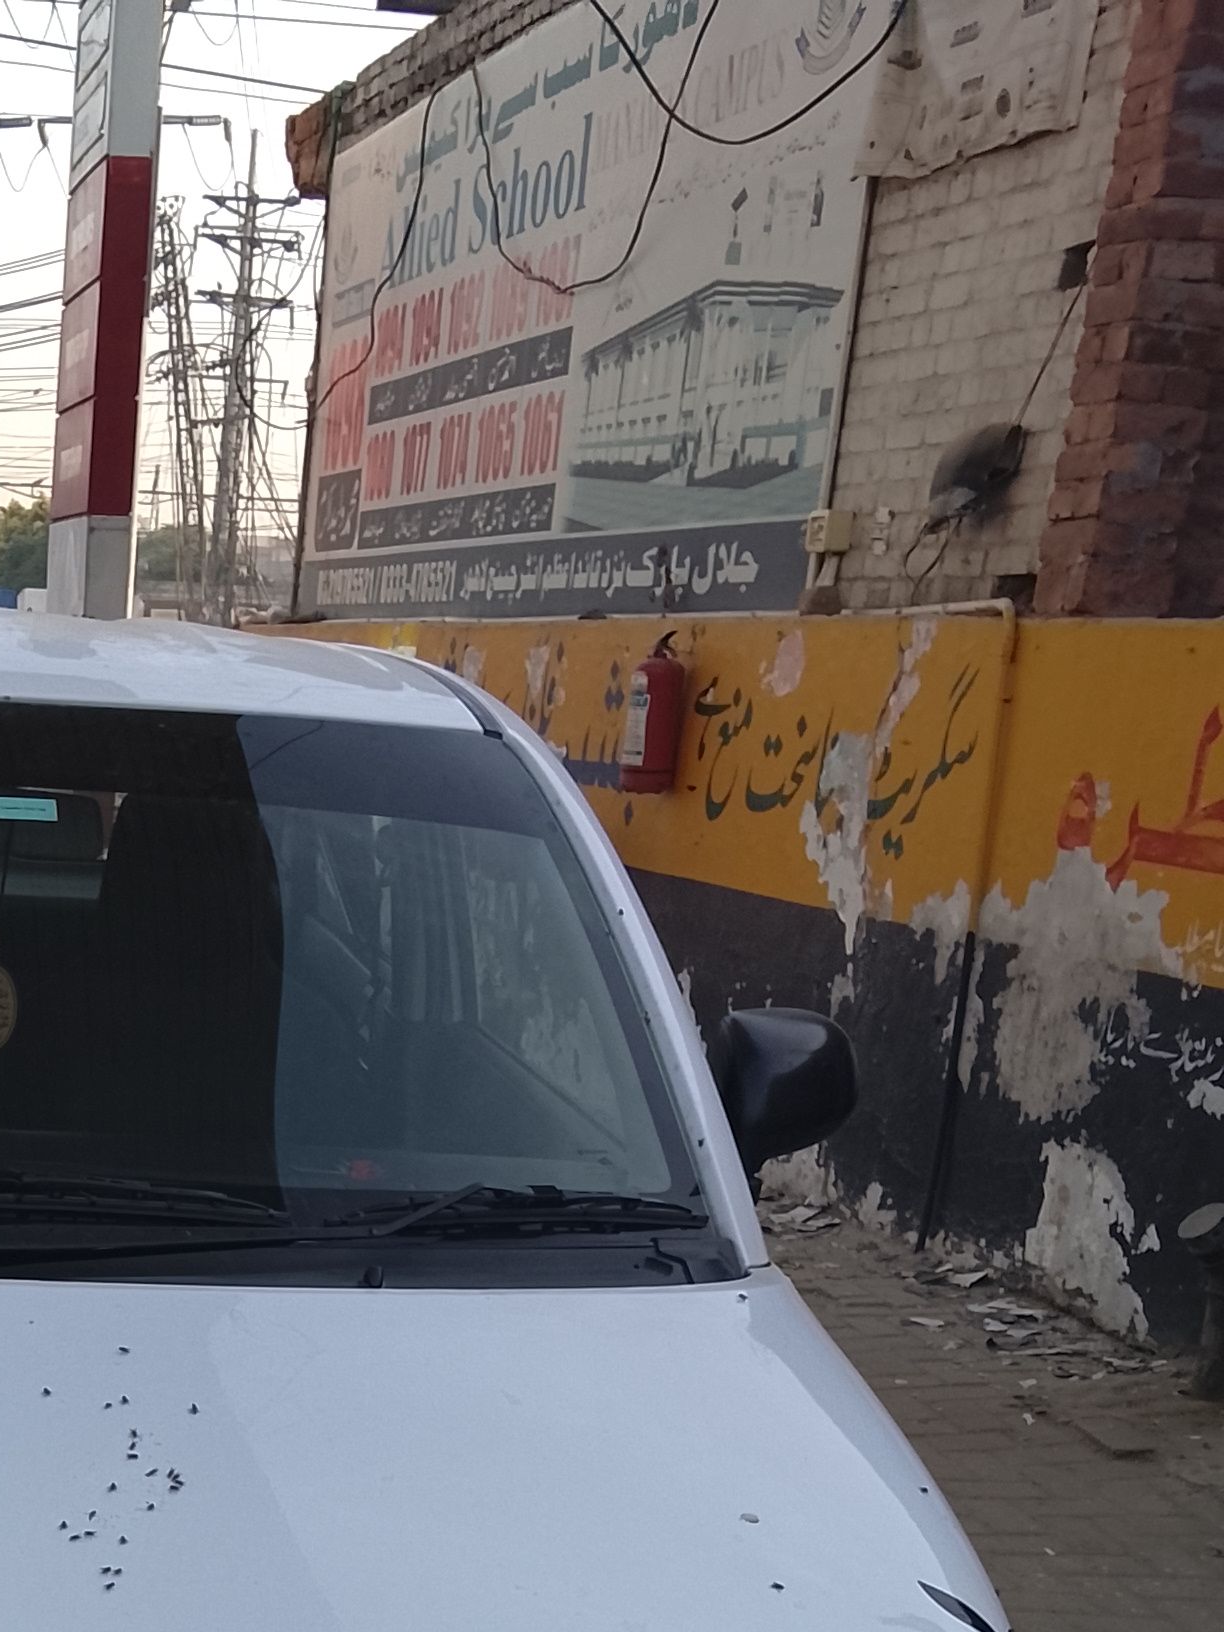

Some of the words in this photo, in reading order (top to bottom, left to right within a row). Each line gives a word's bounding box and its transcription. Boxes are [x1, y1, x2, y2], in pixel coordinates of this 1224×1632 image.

[381, 178, 462, 289] Allied
[468, 112, 593, 253] School
[692, 541, 759, 594] جلال
